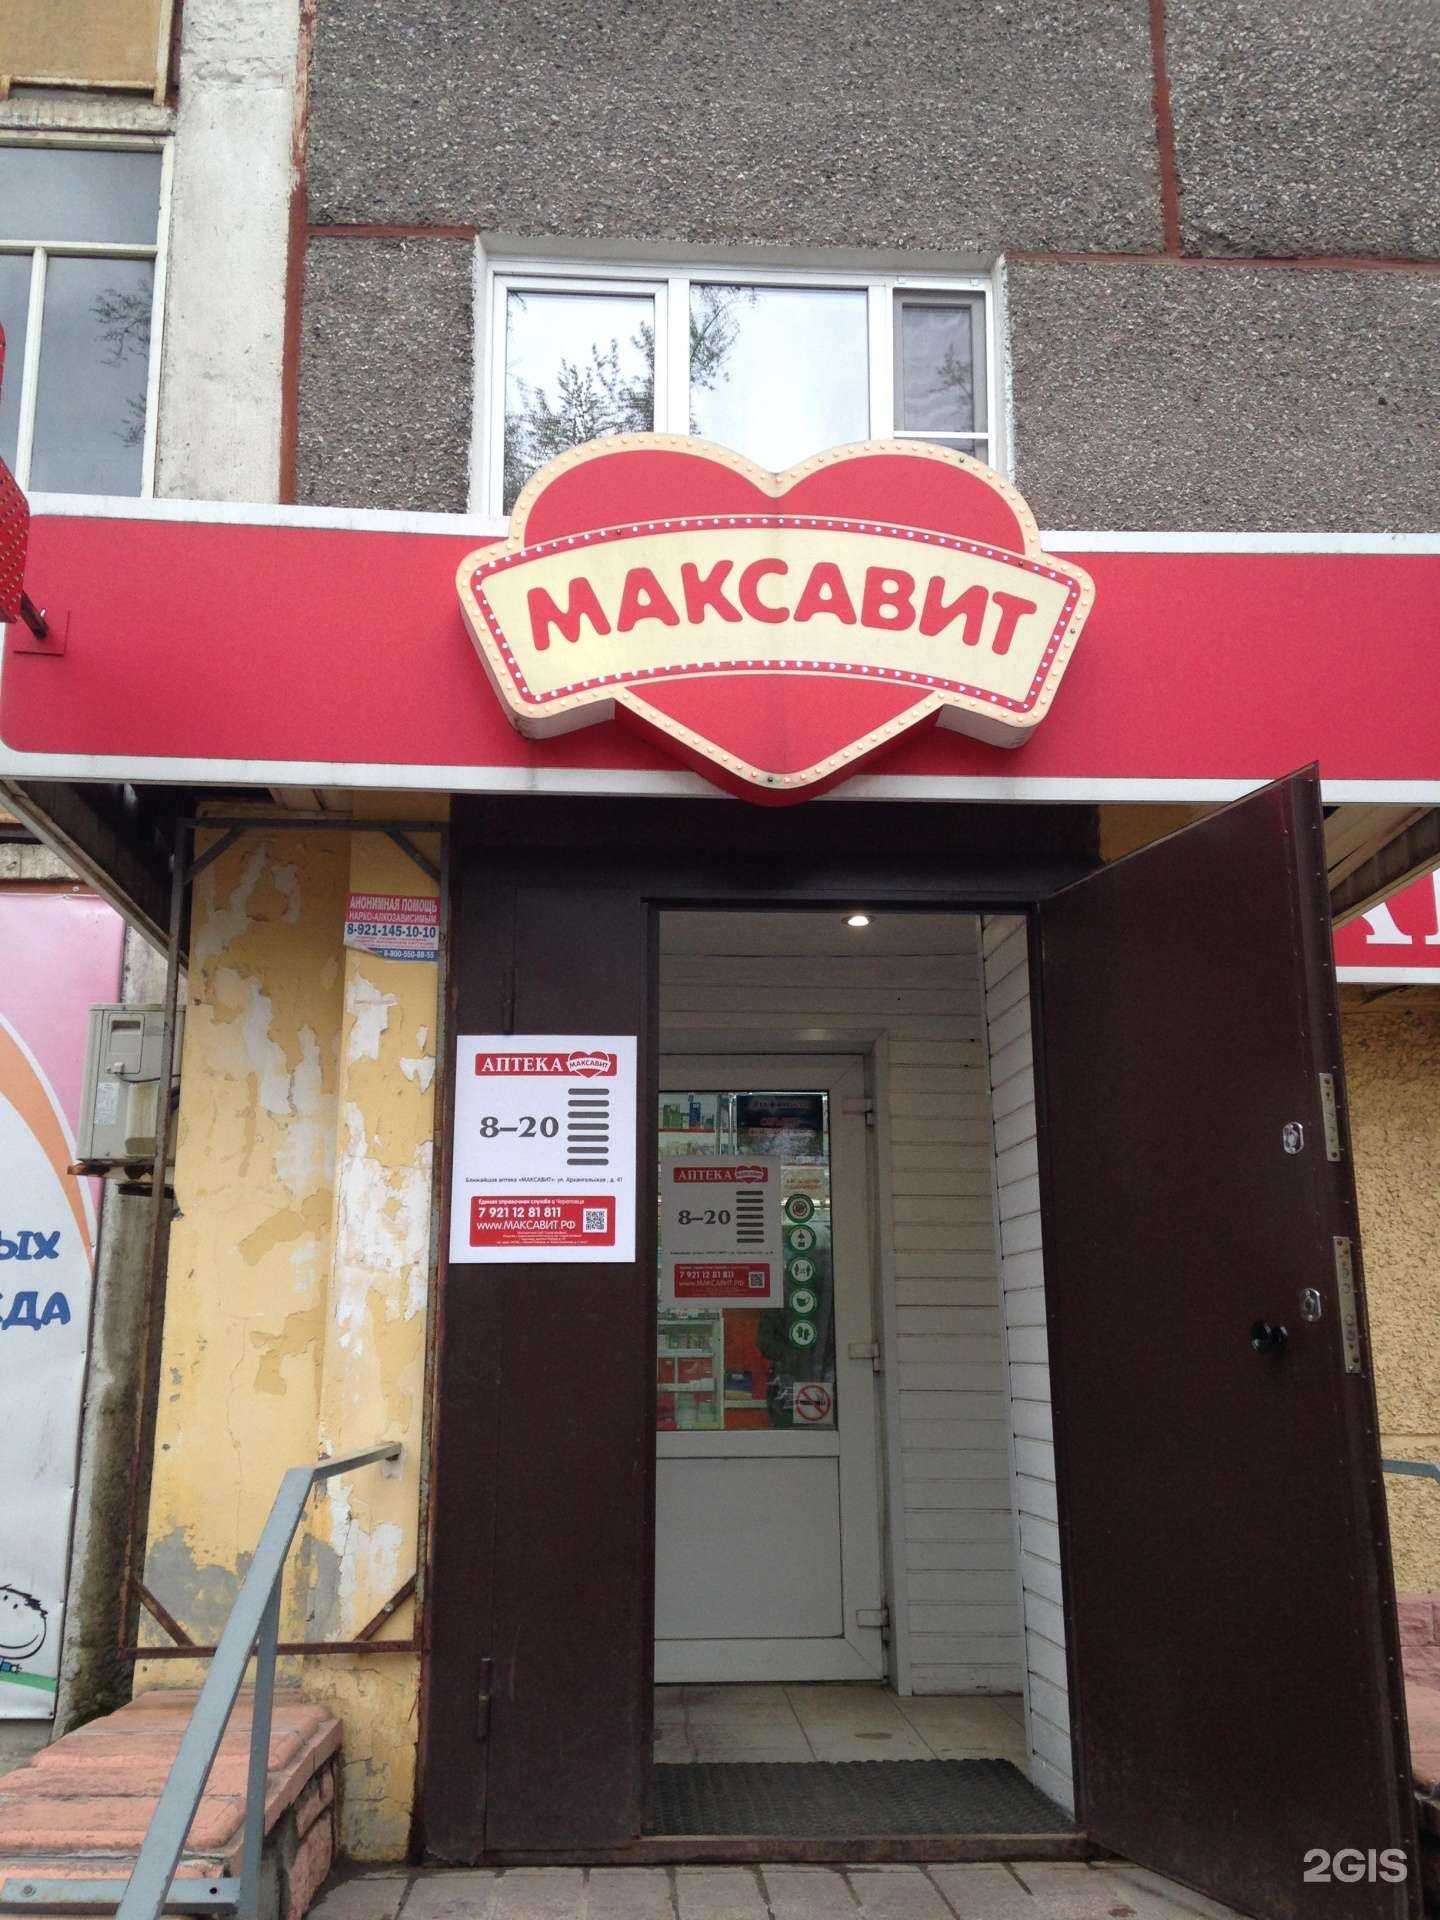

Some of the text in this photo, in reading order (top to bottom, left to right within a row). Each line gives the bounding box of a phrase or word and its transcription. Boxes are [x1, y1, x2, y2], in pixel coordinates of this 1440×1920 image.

[527, 558, 1037, 655] МАКСАВИТ
[350, 895, 438, 914] АНОНИМНАЯ ПОМОЩЬ
[346, 923, 437, 938] 8-921-145-10-10
[481, 1057, 609, 1072] АПТЕКА МАКСАВИТ
[678, 1169, 733, 1180] АПТЕКА
[478, 1207, 561, 1218] 7 921 12 81 811
[0, 1291, 71, 1331] ДА
